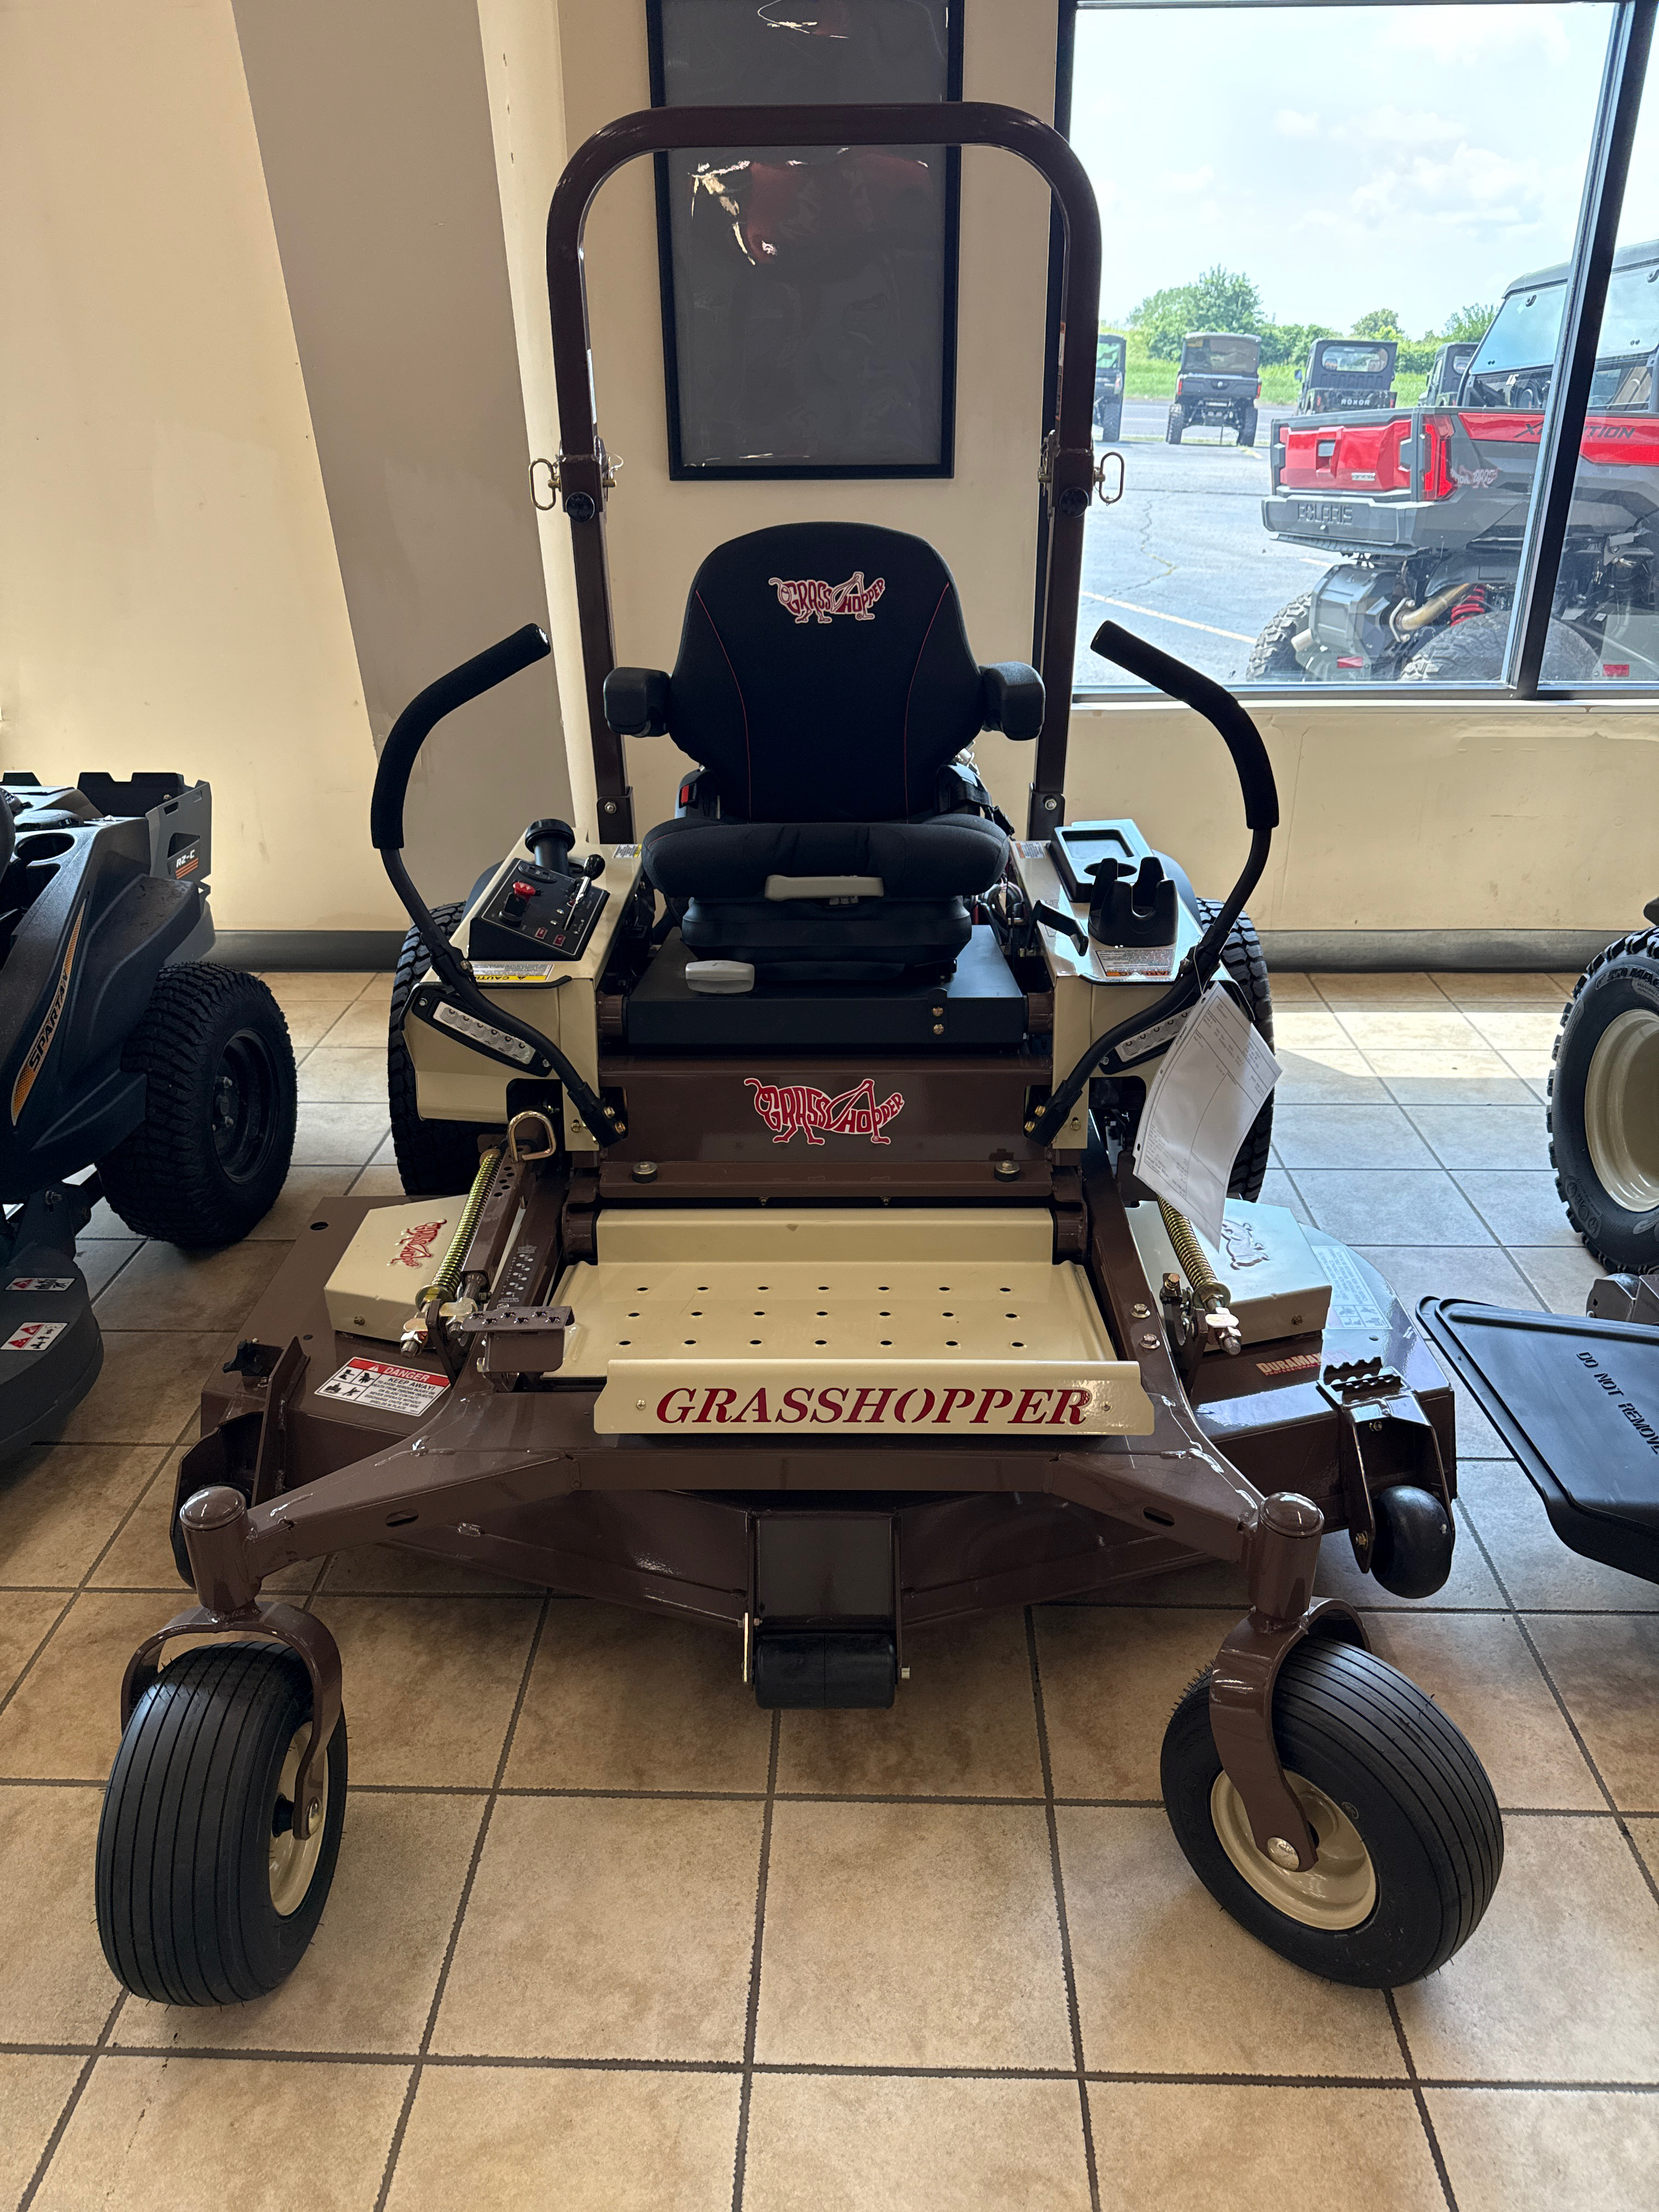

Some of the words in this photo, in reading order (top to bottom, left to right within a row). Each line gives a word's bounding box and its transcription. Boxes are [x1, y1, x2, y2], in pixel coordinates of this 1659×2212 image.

[1297, 503, 1353, 525] POLARIS
[176, 849, 195, 868] RZ-C
[29, 969, 69, 1072] SPARTAN
[755, 1086, 905, 1134] GRASSHOPPER
[383, 1367, 430, 1382] DANGER
[409, 1381, 436, 1391] AWAY!
[1576, 1352, 1599, 1368] DO
[1594, 1373, 1624, 1396] NOT
[656, 1387, 1093, 1425] GRASSHOPPER
